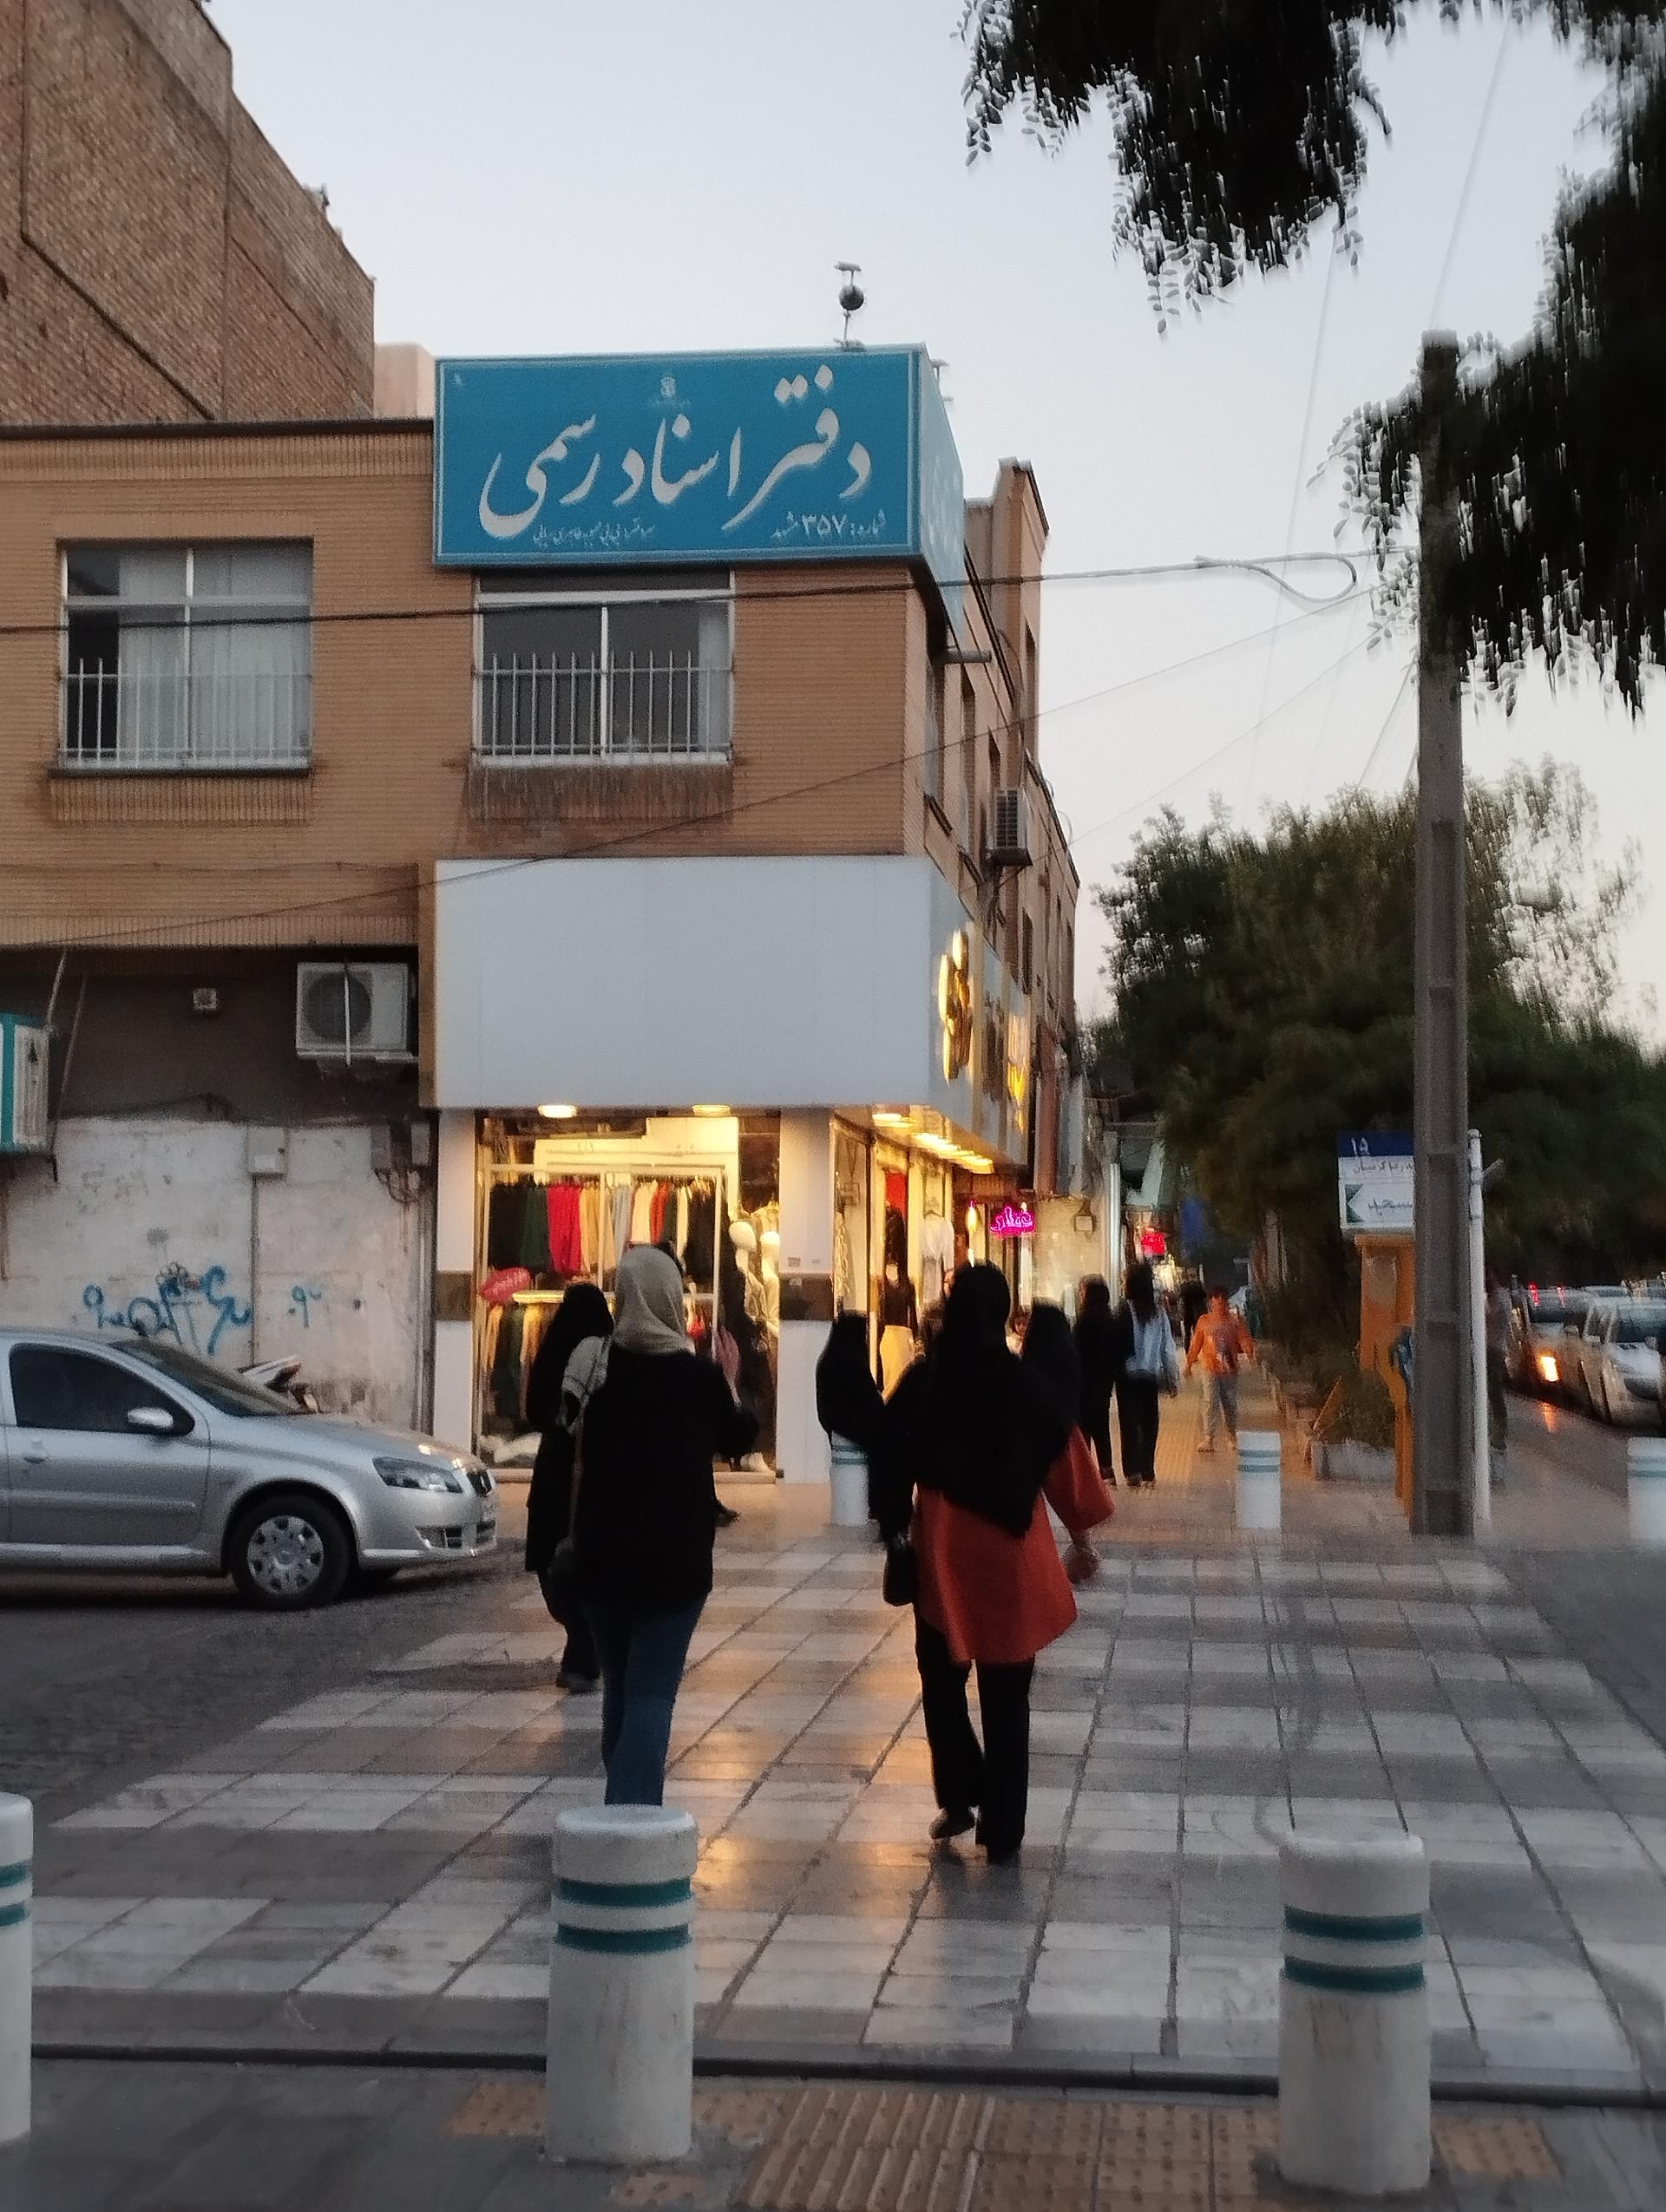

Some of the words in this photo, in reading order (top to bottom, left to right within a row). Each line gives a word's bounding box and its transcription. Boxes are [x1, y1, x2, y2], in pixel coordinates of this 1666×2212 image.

[478, 413, 600, 540] رسمی
[613, 413, 744, 507] اسناد
[721, 364, 871, 531] دفتر
[801, 514, 847, 538] ۳۵۷
